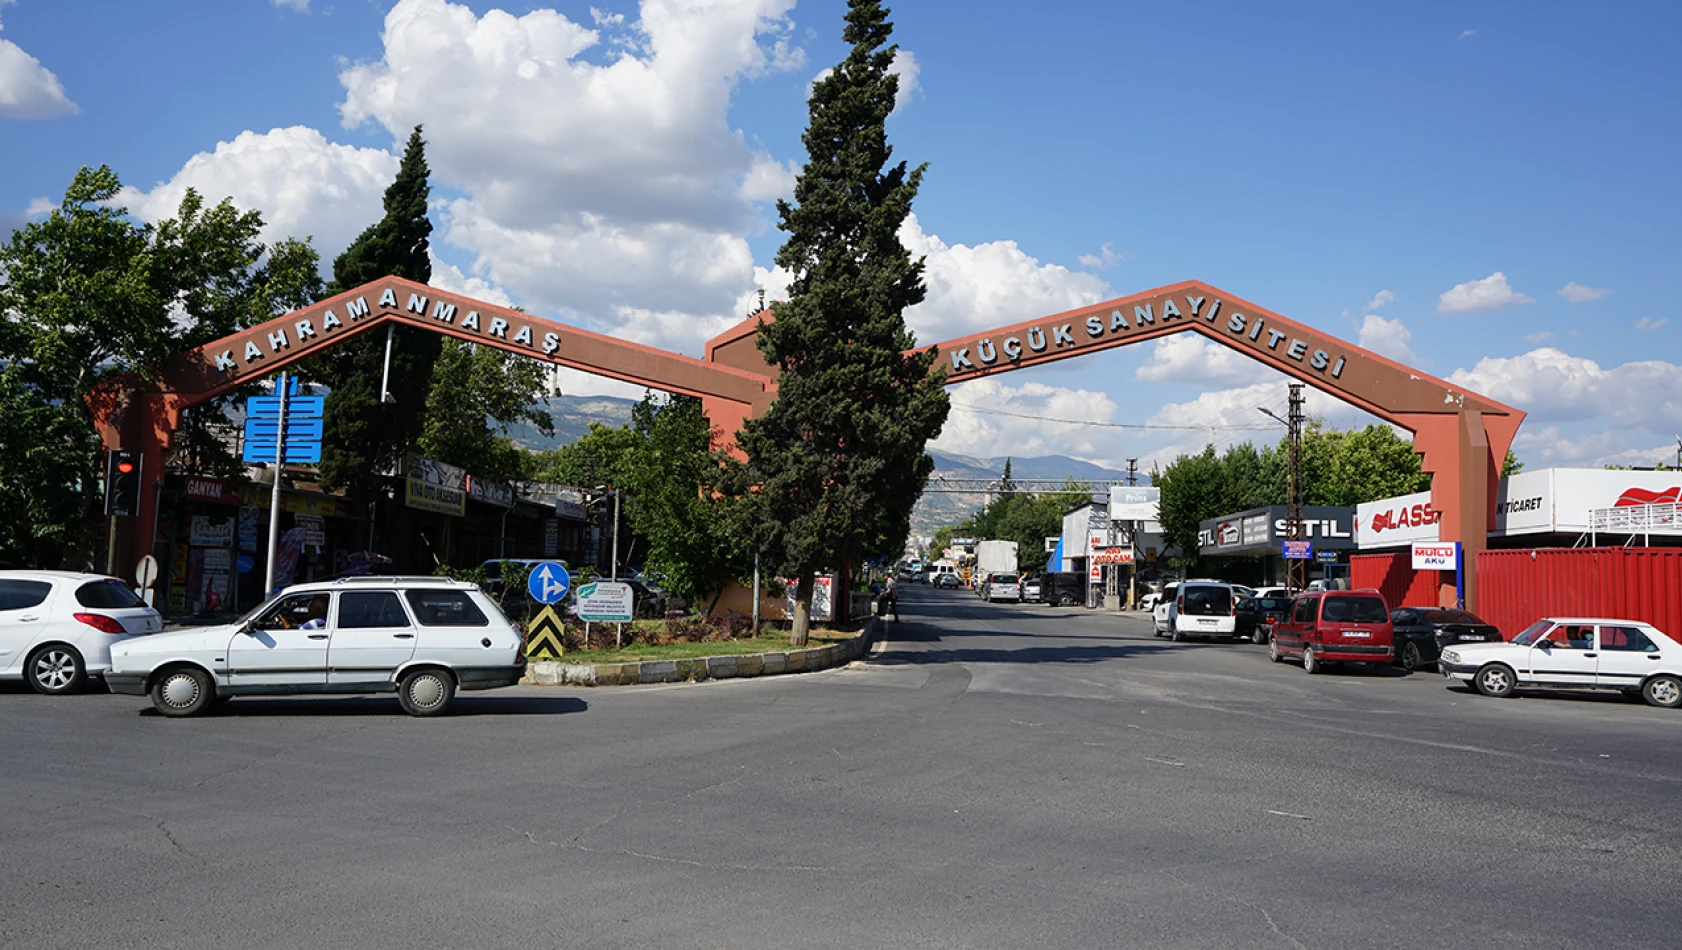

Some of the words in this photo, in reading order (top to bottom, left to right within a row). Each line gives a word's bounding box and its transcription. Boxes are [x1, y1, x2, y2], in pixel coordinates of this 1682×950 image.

[214, 288, 562, 372] KAHRAMANMARAŞ
[950, 323, 1075, 372] KÜÇÜK
[1086, 296, 1222, 337] SANAYİ
[1226, 311, 1348, 379] SİTESİ
[187, 479, 223, 498] GANYAN
[1387, 502, 1440, 530] LASS
[1505, 496, 1543, 514] TİCARET
[1095, 555, 1113, 564] OTO
[1113, 554, 1132, 563] CAM
